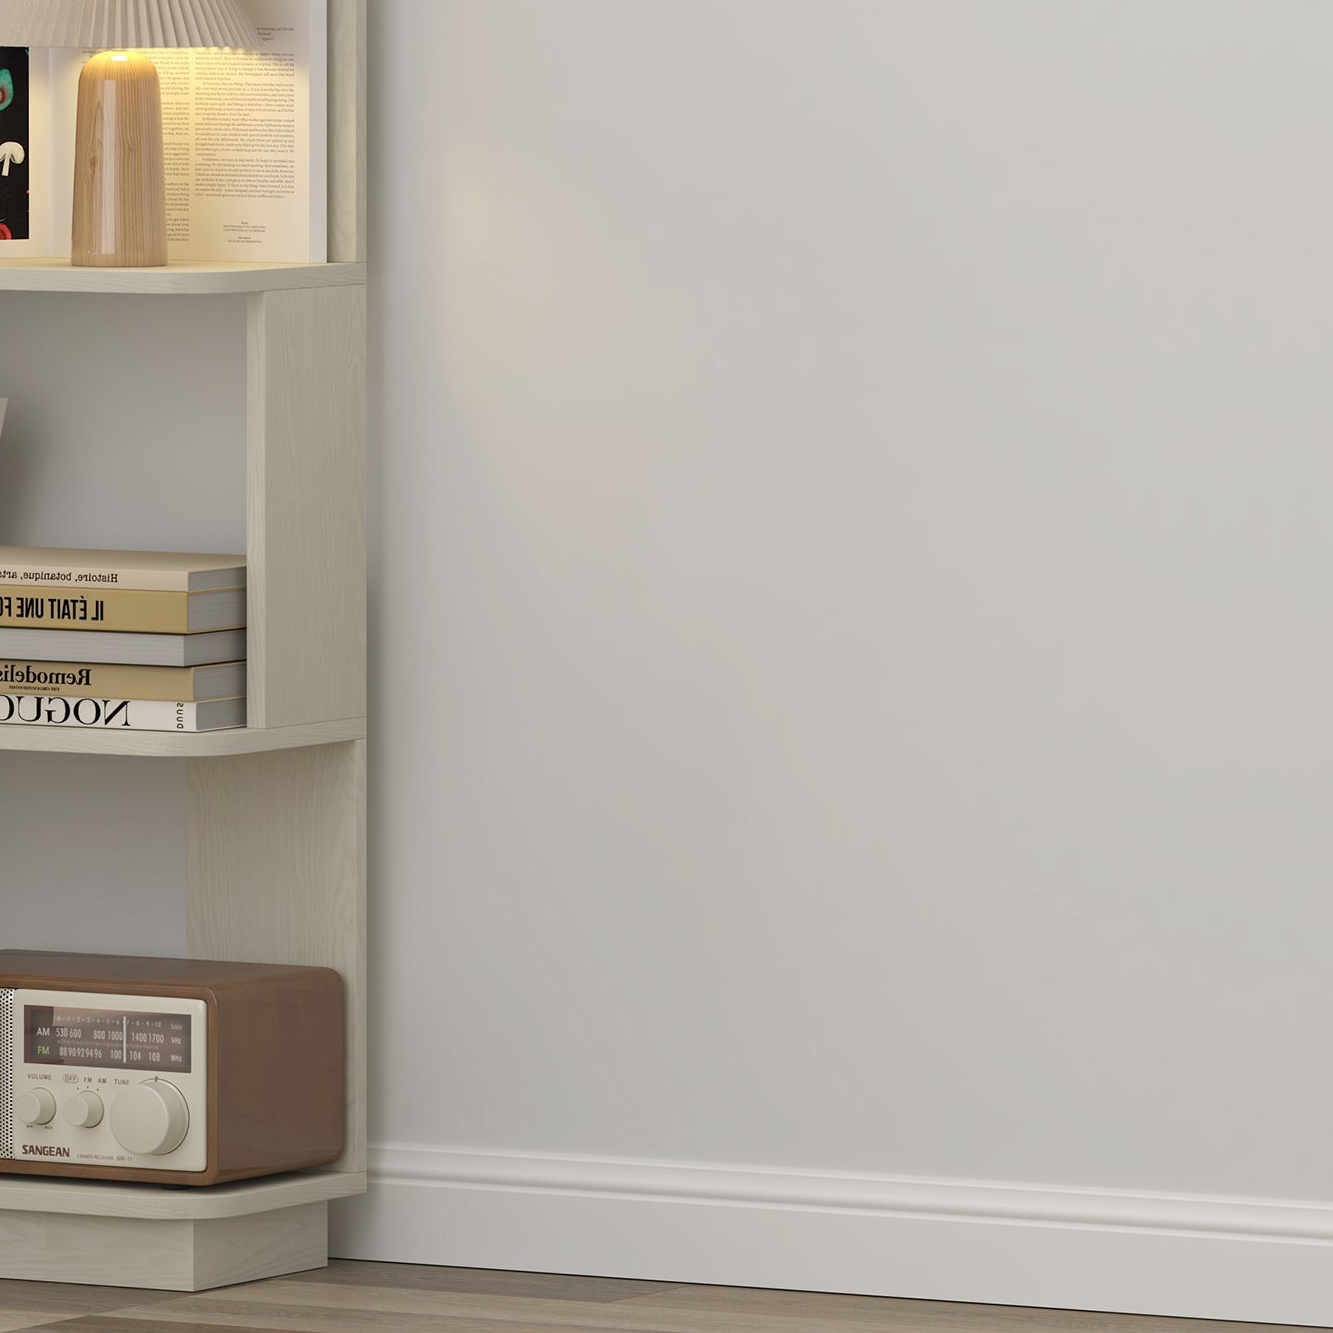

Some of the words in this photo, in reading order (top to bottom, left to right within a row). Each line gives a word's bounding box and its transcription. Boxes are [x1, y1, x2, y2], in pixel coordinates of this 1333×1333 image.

[36, 1027, 50, 1036] AM
[56, 1028, 68, 1038] 530
[70, 1029, 82, 1038] 600
[93, 1030, 105, 1040] 800
[108, 1031, 123, 1041] 1000
[132, 1032, 148, 1043] 1400
[148, 1033, 164, 1044] 1700
[37, 1046, 50, 1055] FM
[110, 1049, 122, 1059] 100
[130, 1050, 142, 1060] 104
[148, 1052, 160, 1062] 108
[27, 1073, 52, 1081] VOLUME
[64, 1074, 77, 1082] OFF
[84, 1076, 92, 1084] FM
[114, 1078, 130, 1086] TUNE
[22, 1144, 70, 1158] SANGEAN
